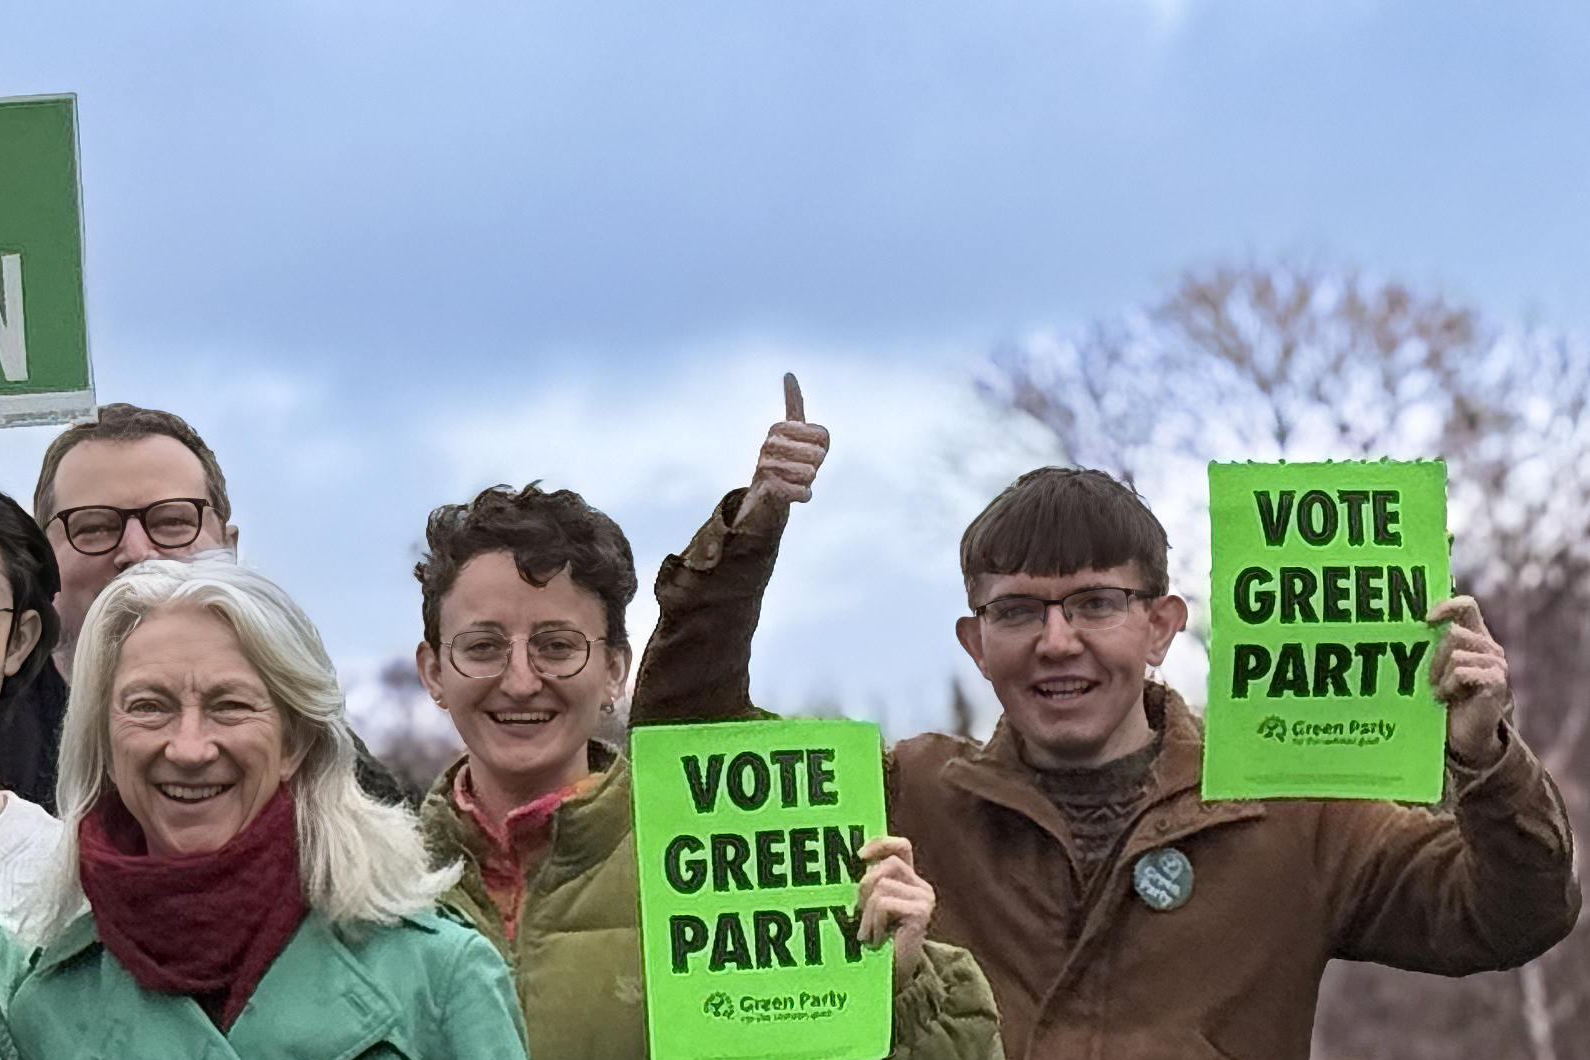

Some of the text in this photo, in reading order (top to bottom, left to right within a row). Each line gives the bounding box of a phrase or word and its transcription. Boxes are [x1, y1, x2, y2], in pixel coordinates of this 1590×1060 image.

[1254, 490, 1402, 547] VOTE
[1234, 566, 1428, 624] GREEN
[1232, 641, 1430, 698] PARTY
[1292, 719, 1395, 741] Green Party
[681, 749, 839, 813] VOTE
[665, 825, 865, 894] GREEN
[670, 905, 863, 974] PARTY
[740, 990, 847, 1012] Green Party
